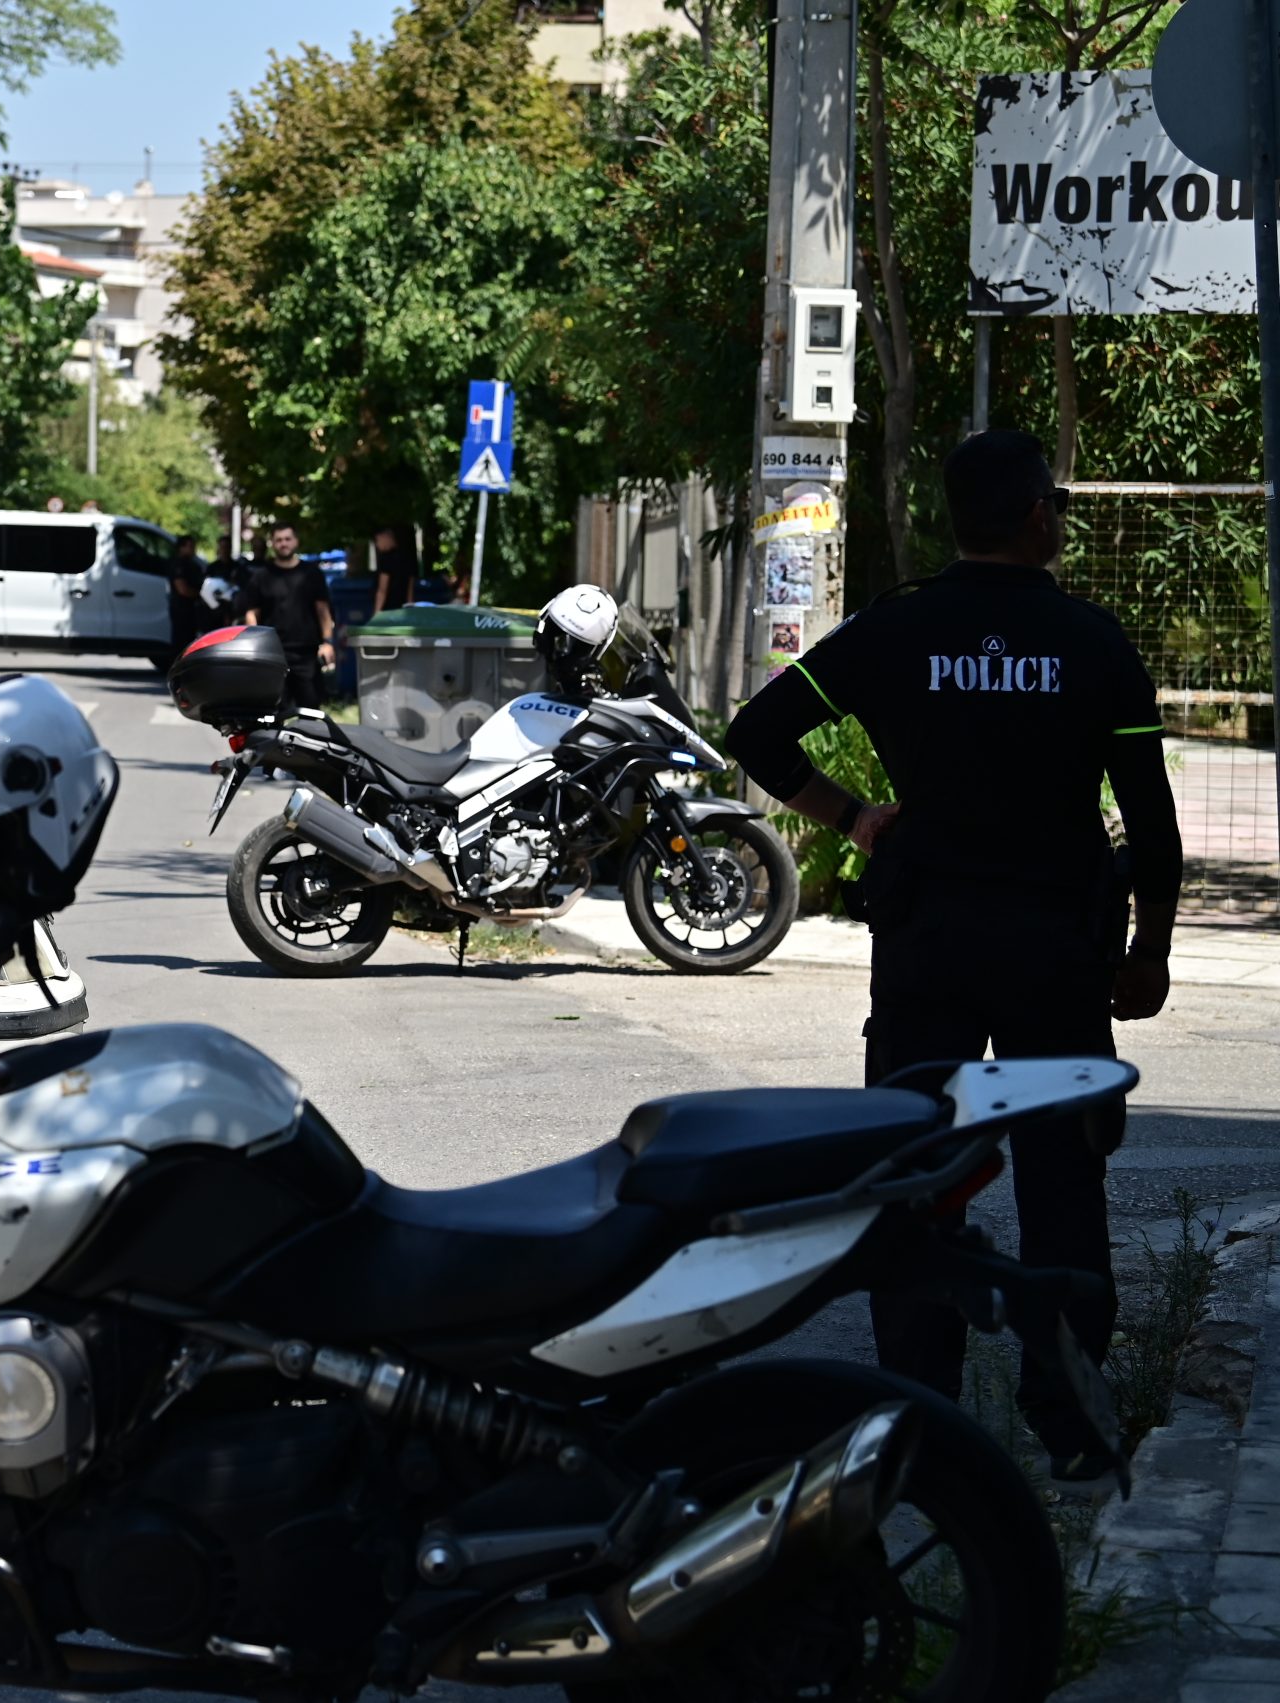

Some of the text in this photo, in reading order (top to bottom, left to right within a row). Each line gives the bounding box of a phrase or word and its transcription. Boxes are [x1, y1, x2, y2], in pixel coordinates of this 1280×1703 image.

[991, 161, 1280, 225] Workou
[792, 453, 822, 466] 844
[928, 655, 1060, 693] POLICE
[509, 702, 582, 719] OLICE
